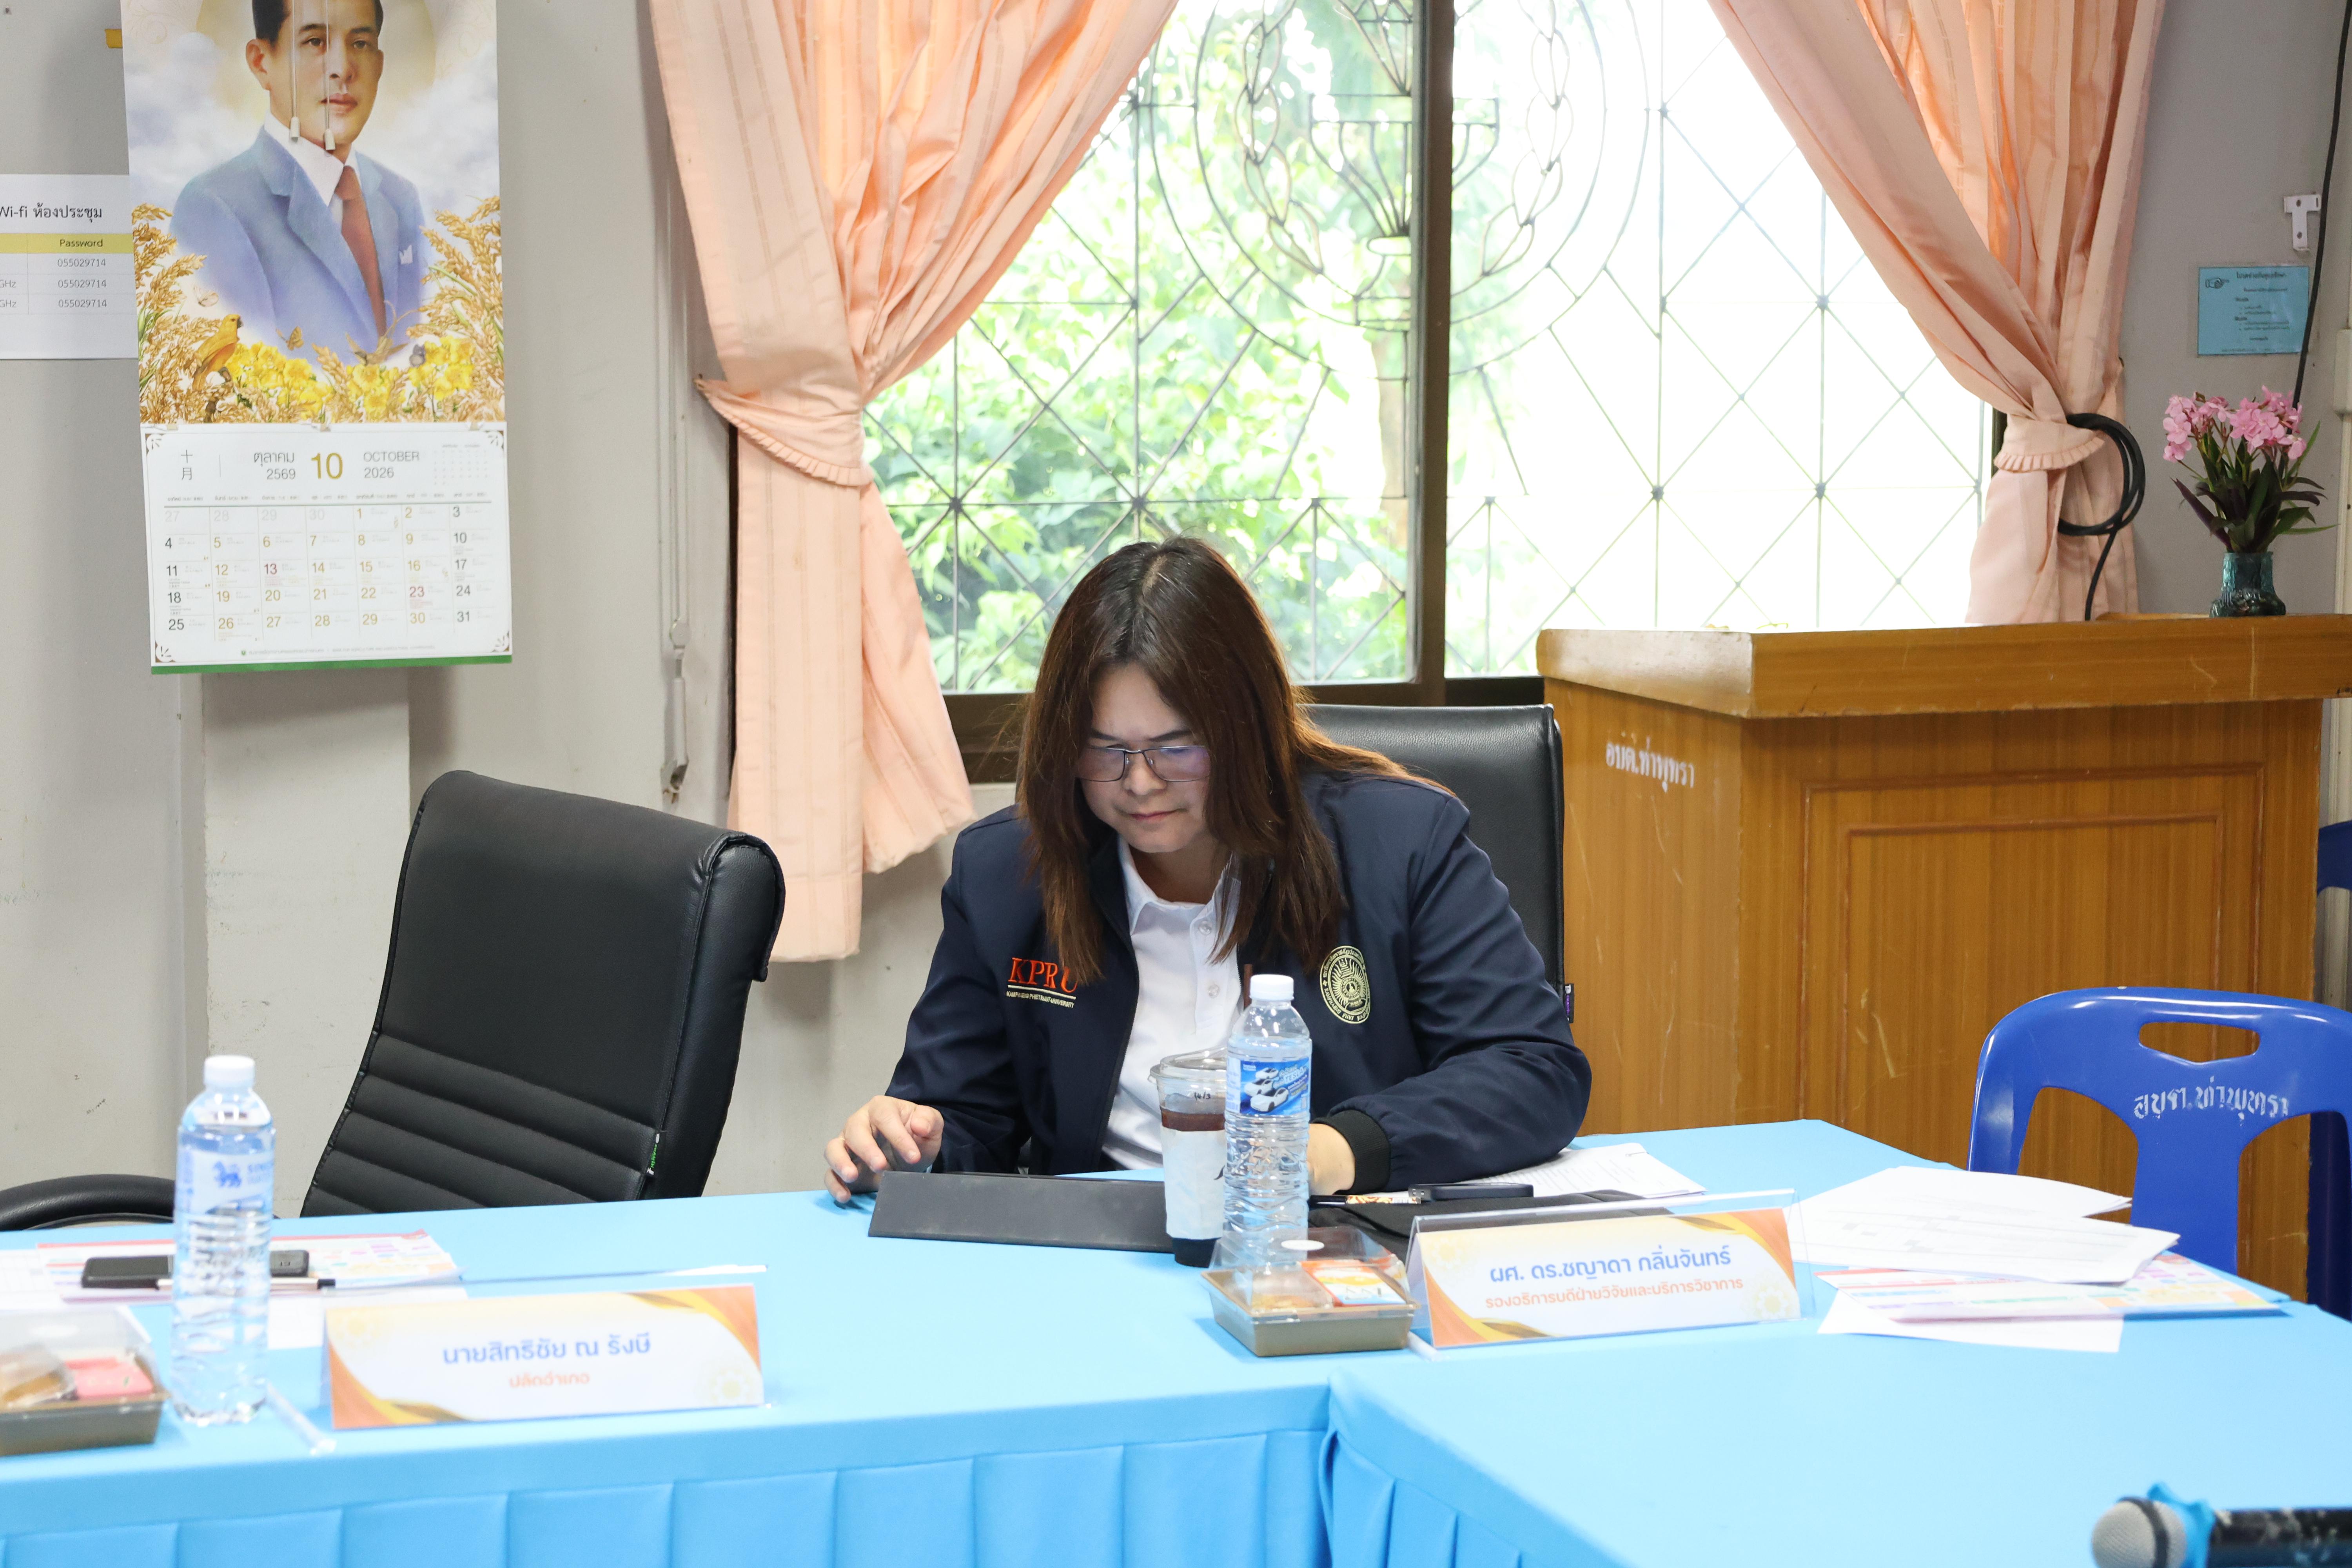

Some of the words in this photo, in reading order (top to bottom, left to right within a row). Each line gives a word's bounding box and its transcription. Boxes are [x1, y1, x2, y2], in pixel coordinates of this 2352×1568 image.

[0, 206, 27, 218] Wi-fi
[33, 202, 102, 223] ห้องประชุม
[60, 239, 103, 247] Password
[58, 258, 106, 267] 055029714
[58, 279, 106, 288] 055029714
[58, 299, 107, 308] 055029714
[254, 452, 294, 467] ตุลาคม
[363, 450, 419, 462] OCTOBER
[311, 452, 343, 479] 10
[364, 467, 394, 478] 2026
[267, 468, 296, 480] 2569
[357, 508, 362, 519] 1
[405, 507, 412, 519] 2
[453, 505, 460, 517] 3
[165, 537, 172, 549] 4
[214, 537, 221, 548] 5
[263, 536, 270, 547] 6
[310, 535, 316, 546] 7
[358, 535, 365, 546] 8
[406, 534, 413, 545] 9
[453, 532, 467, 544] 10
[166, 565, 177, 576] 11
[215, 564, 229, 575] 12
[264, 563, 277, 575] 13
[312, 563, 325, 573] 14
[359, 561, 373, 573] 15
[407, 560, 421, 571] 16
[455, 559, 467, 570] 17
[168, 592, 181, 603] 18
[216, 591, 230, 602] 19
[265, 590, 281, 601] 20
[314, 588, 327, 600] 21
[361, 588, 376, 599] 22
[409, 586, 425, 597] 23
[456, 585, 470, 597] 24
[169, 619, 184, 630] 25
[218, 618, 234, 629] 26
[267, 617, 281, 628] 27
[315, 615, 330, 627] 28
[363, 614, 377, 625] 29
[410, 613, 425, 624] 30
[457, 612, 470, 622] 31
[1490, 1266, 1524, 1282] ผศ.
[1531, 1258, 1632, 1280] ดร.ชญาดา
[1638, 1245, 1731, 1272] กลิ่นจันทร์
[1485, 1278, 1744, 1308] รองอธิการบดีฝ่ายวิจัยและบริการวิชาการ
[443, 1338, 567, 1365] นายสิทธิชัย
[575, 1341, 599, 1357] ณ
[608, 1332, 651, 1355] รังษี
